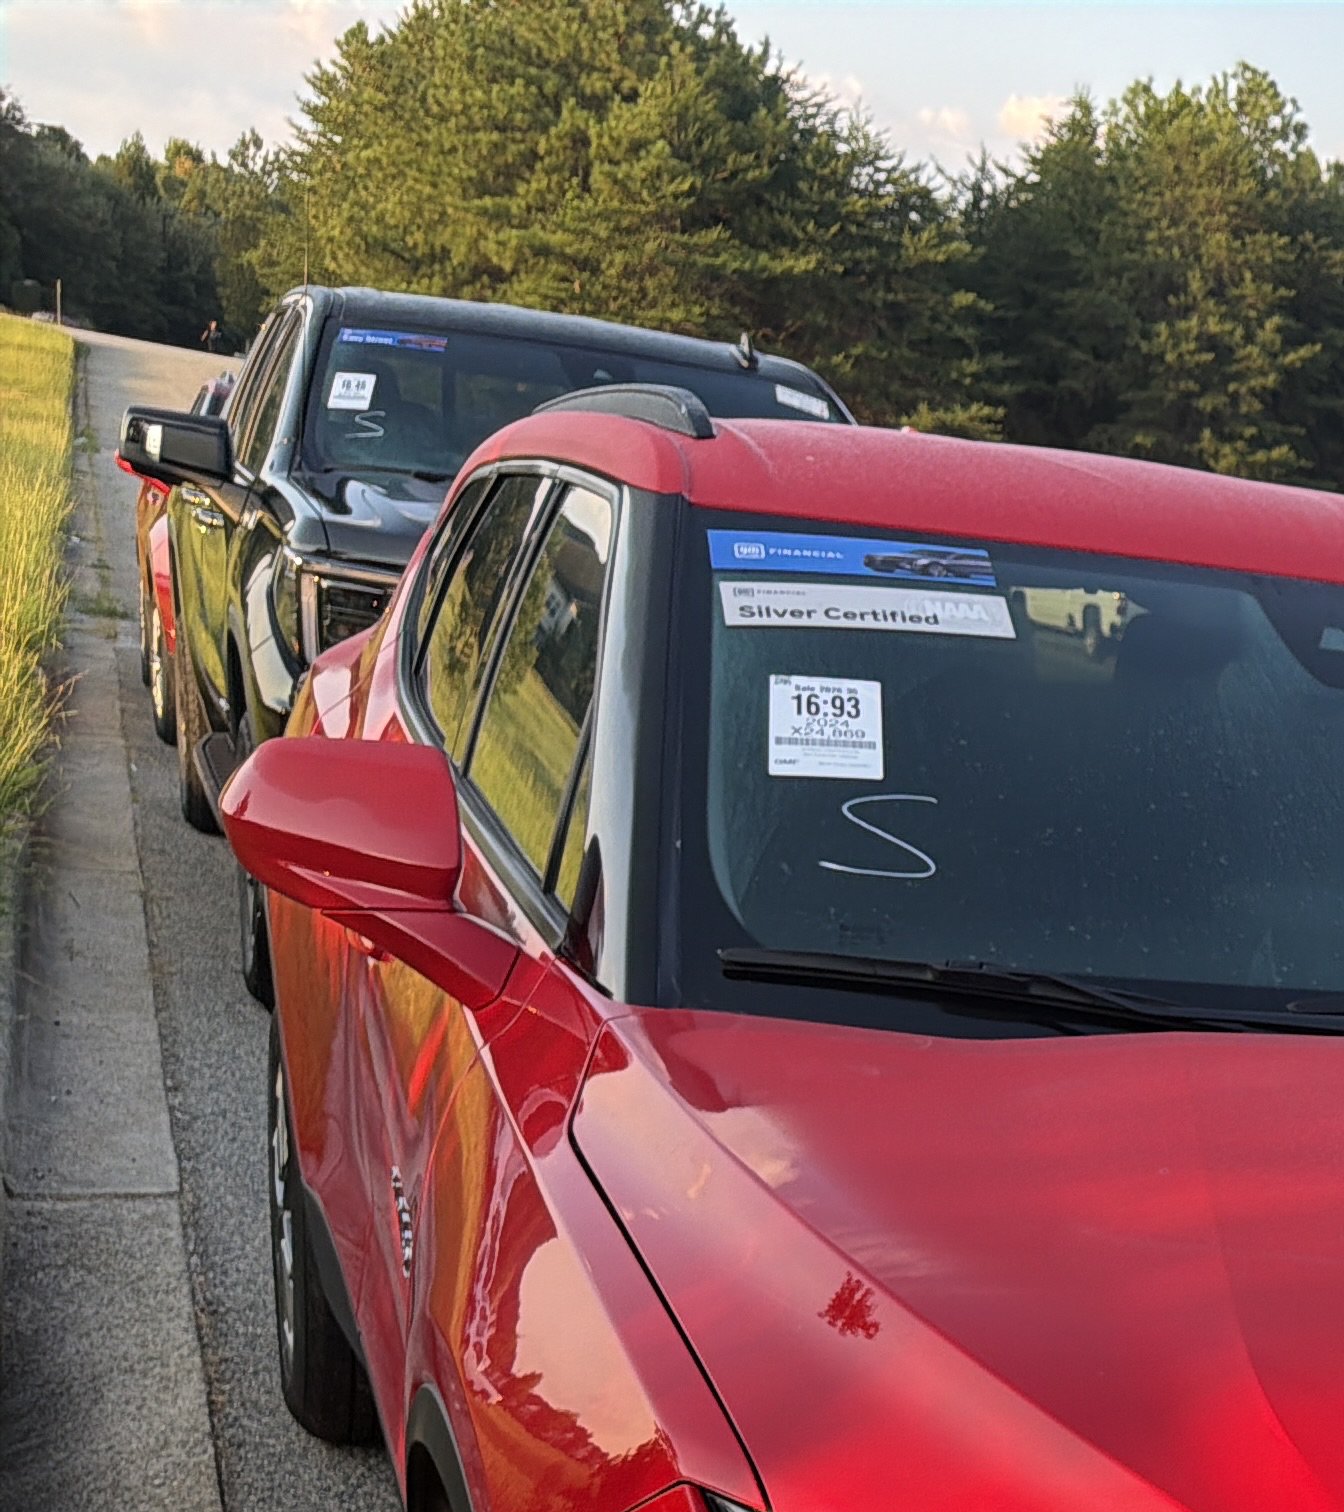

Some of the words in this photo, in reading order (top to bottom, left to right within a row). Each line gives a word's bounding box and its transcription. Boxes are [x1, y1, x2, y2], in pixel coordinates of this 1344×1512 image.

[769, 547, 844, 559] FINANCIAL
[738, 603, 818, 620] Silver
[823, 606, 940, 626] Certified
[791, 693, 861, 719] 16:93
[805, 717, 850, 729] 2024
[818, 794, 938, 878] S
